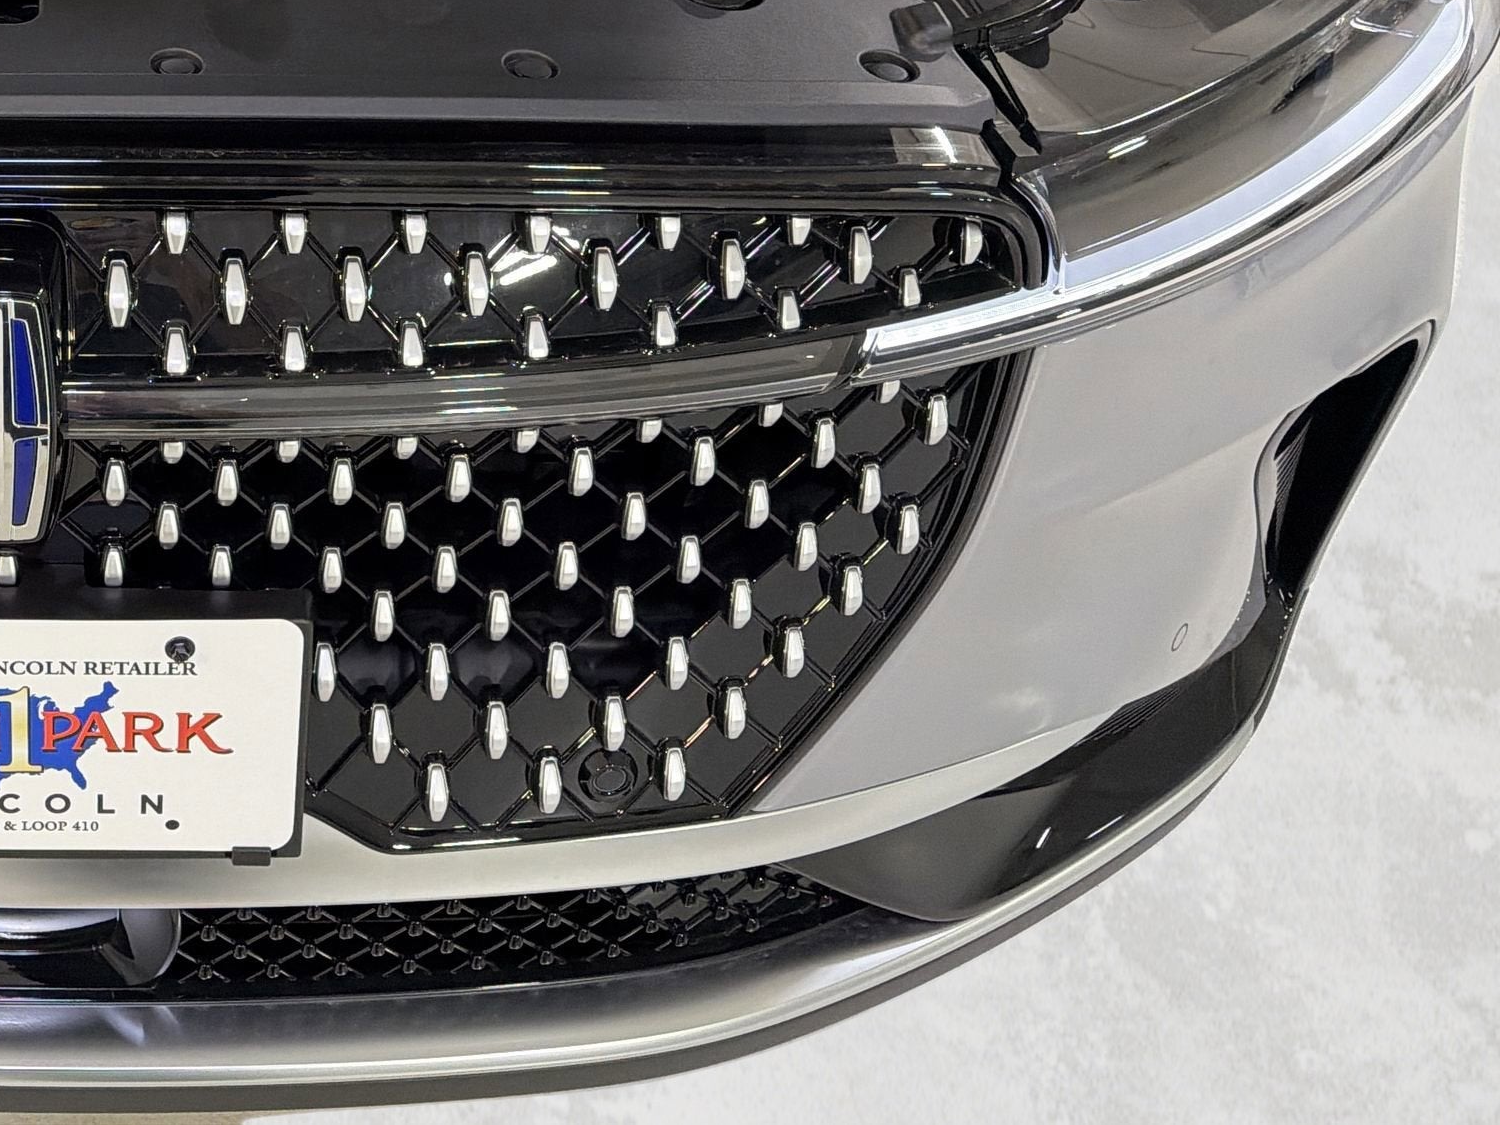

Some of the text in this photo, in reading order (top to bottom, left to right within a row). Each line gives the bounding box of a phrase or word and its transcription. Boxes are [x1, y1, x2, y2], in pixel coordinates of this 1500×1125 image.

[83, 661, 198, 676] RETAILER
[41, 711, 234, 754] PARK
[3, 820, 17, 831] &
[21, 820, 67, 831] LOOP
[72, 821, 99, 832] 410
